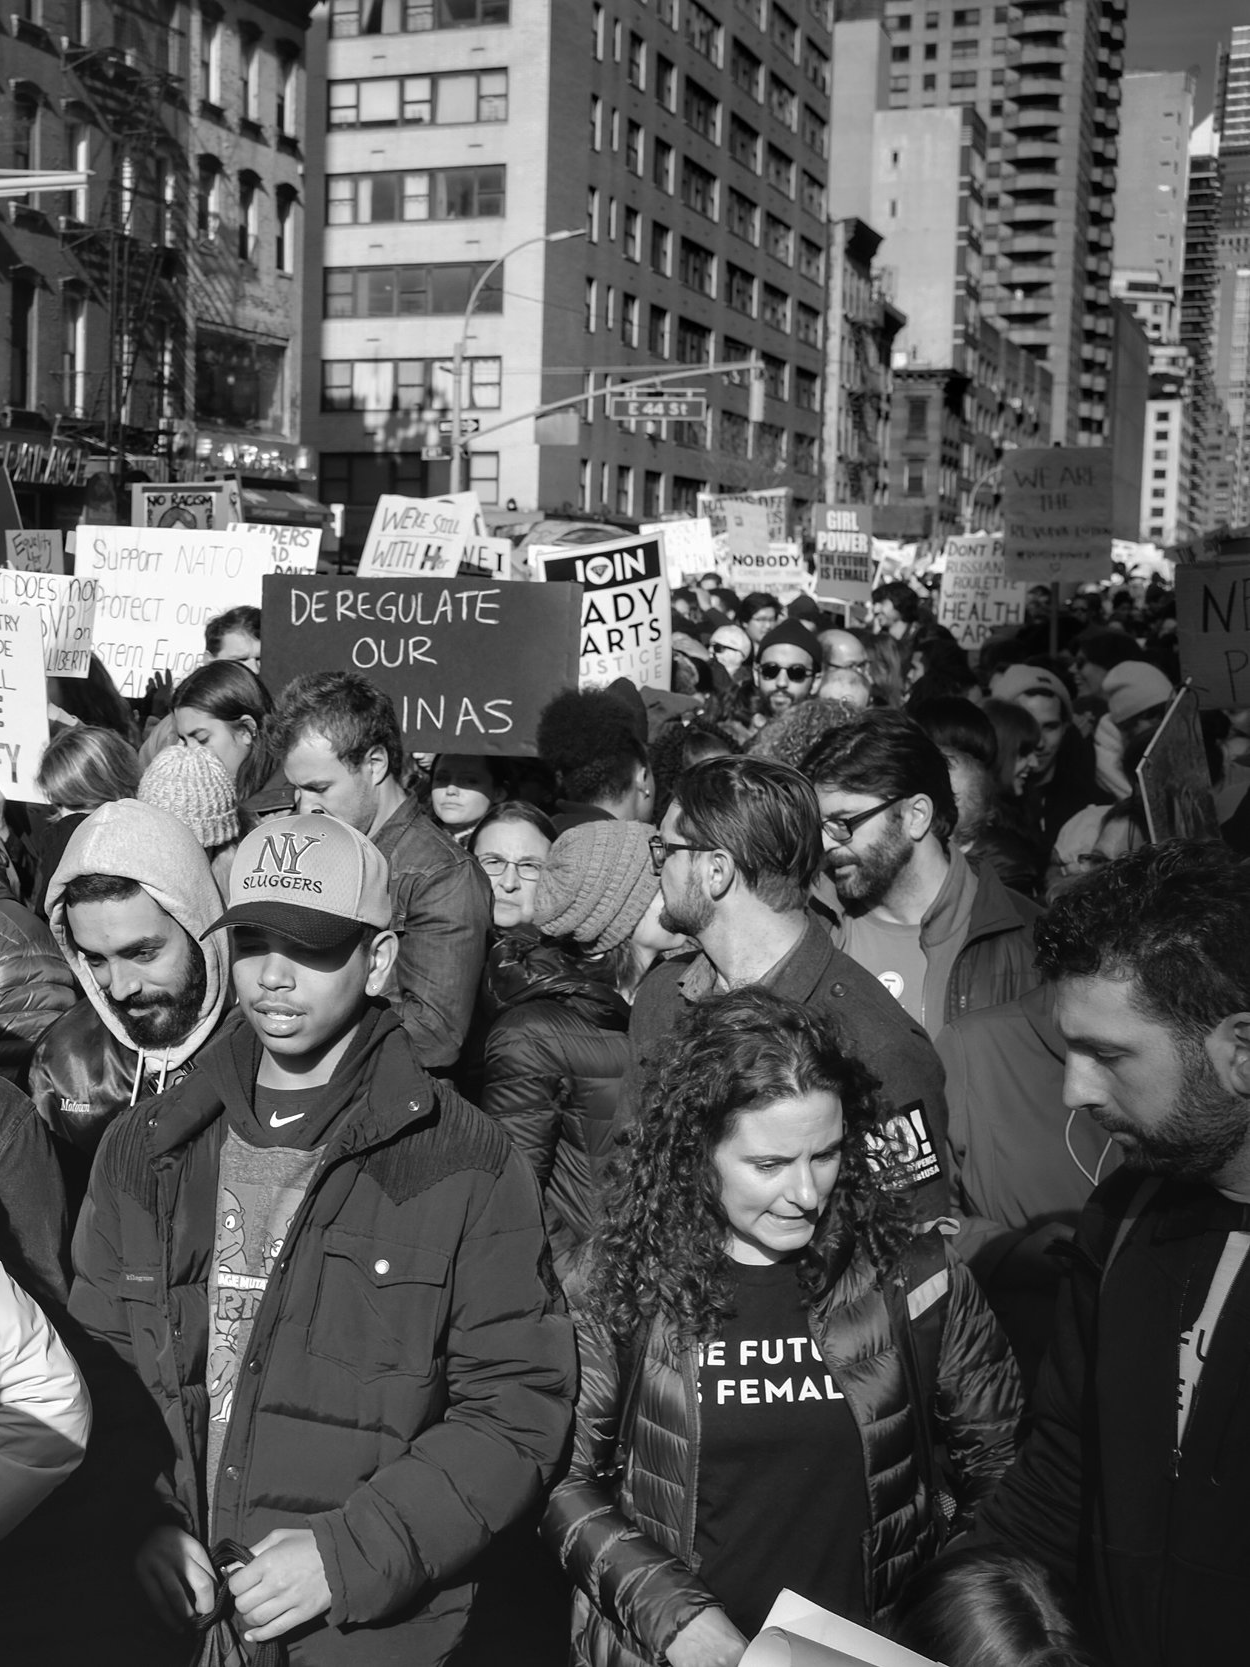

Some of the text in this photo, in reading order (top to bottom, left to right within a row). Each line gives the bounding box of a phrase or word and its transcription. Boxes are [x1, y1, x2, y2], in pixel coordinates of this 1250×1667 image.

[628, 402, 688, 416] E 44 St
[1013, 466, 1096, 488] WE ARE
[147, 494, 166, 506] NO
[826, 510, 859, 531] GIRL
[817, 531, 869, 553] POWER
[174, 545, 243, 578] NATO
[372, 540, 419, 568] WITH
[732, 555, 801, 567] NOBODY
[820, 567, 831, 580] IS
[15, 574, 58, 601] DOES
[291, 588, 501, 626] DEREGULATE
[583, 584, 659, 628] ADY
[942, 601, 1020, 622] HEALTH
[581, 618, 661, 657] ARTS
[950, 623, 988, 643] CAR
[46, 649, 89, 672] LIBERTY
[352, 636, 438, 668] OUR
[402, 695, 513, 736] INAS
[252, 832, 320, 874] NY
[243, 874, 323, 894] SLUGGERS
[717, 1375, 845, 1405] FEMAL
